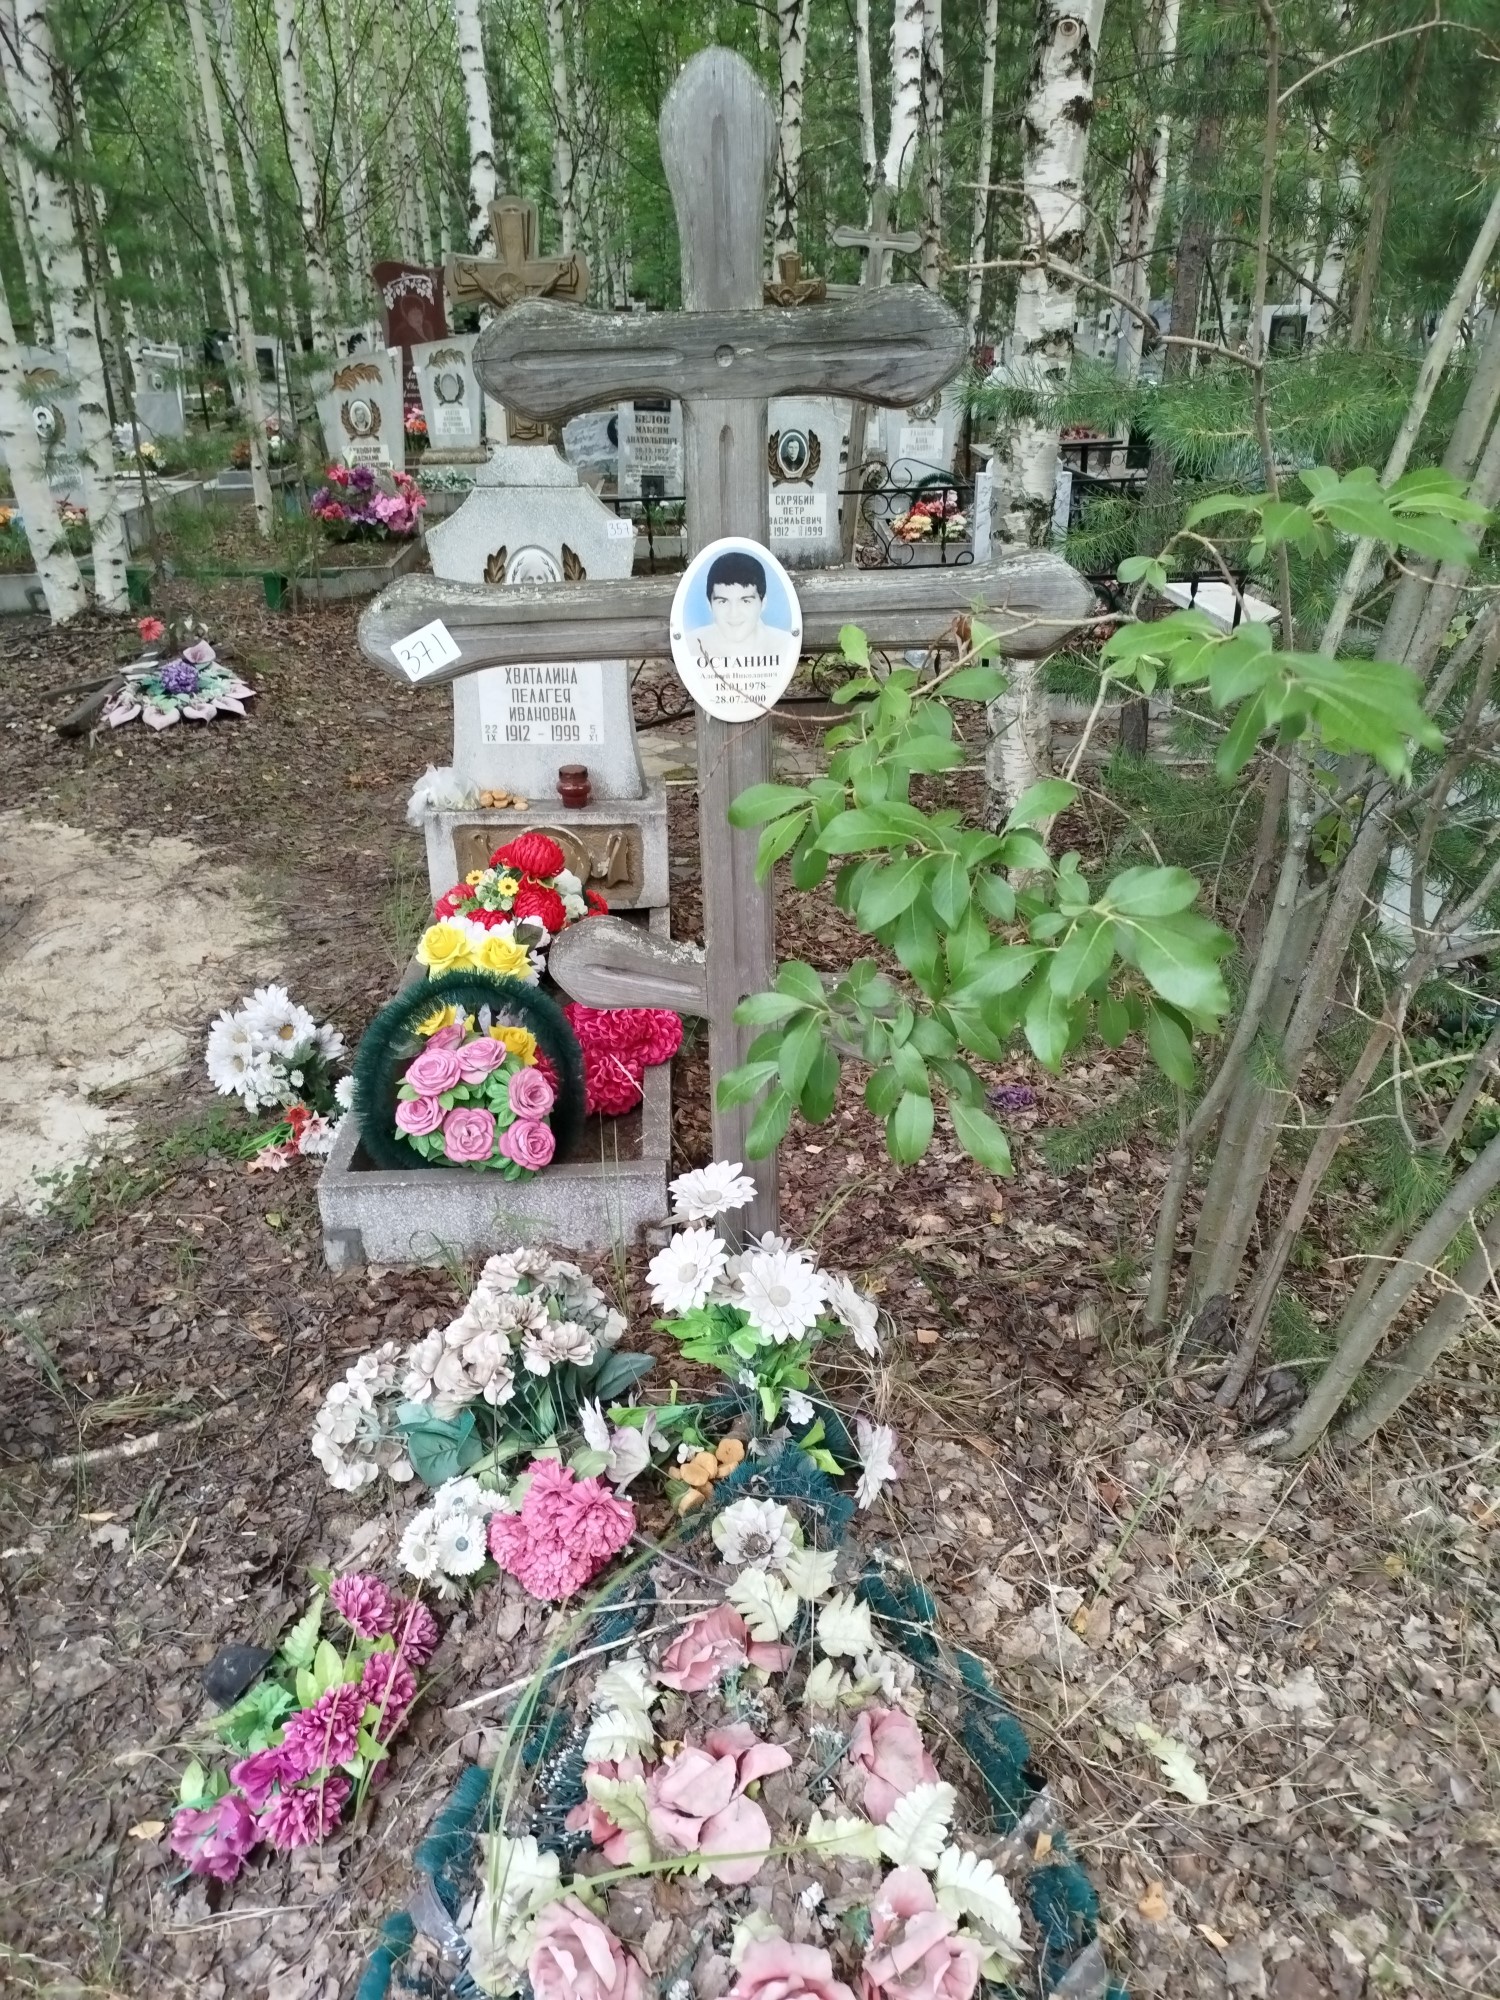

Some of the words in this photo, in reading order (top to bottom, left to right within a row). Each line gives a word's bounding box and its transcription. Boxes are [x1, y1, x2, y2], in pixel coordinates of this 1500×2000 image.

[635, 415, 670, 425] БЕЛОВ
[636, 426, 669, 435] МАКСИМ
[626, 436, 678, 446] АНАТОЛЬЕВИЧ
[775, 495, 815, 506] СКРЯБИН
[783, 506, 805, 515] ПЕТР
[609, 522, 631, 536] 357
[774, 526, 790, 537] 1912
[804, 526, 823, 536] 1999
[400, 633, 448, 675] 371
[696, 655, 780, 668] ОСТАНИН
[505, 667, 578, 685] ХВАТАЛИНА
[700, 672, 731, 680] Алекей
[511, 688, 572, 703] ПЕЛАГЕЯ
[509, 706, 577, 722] ИВАНОВНА
[484, 724, 498, 734] 22
[505, 724, 531, 742] 1912
[551, 724, 580, 742] 1999
